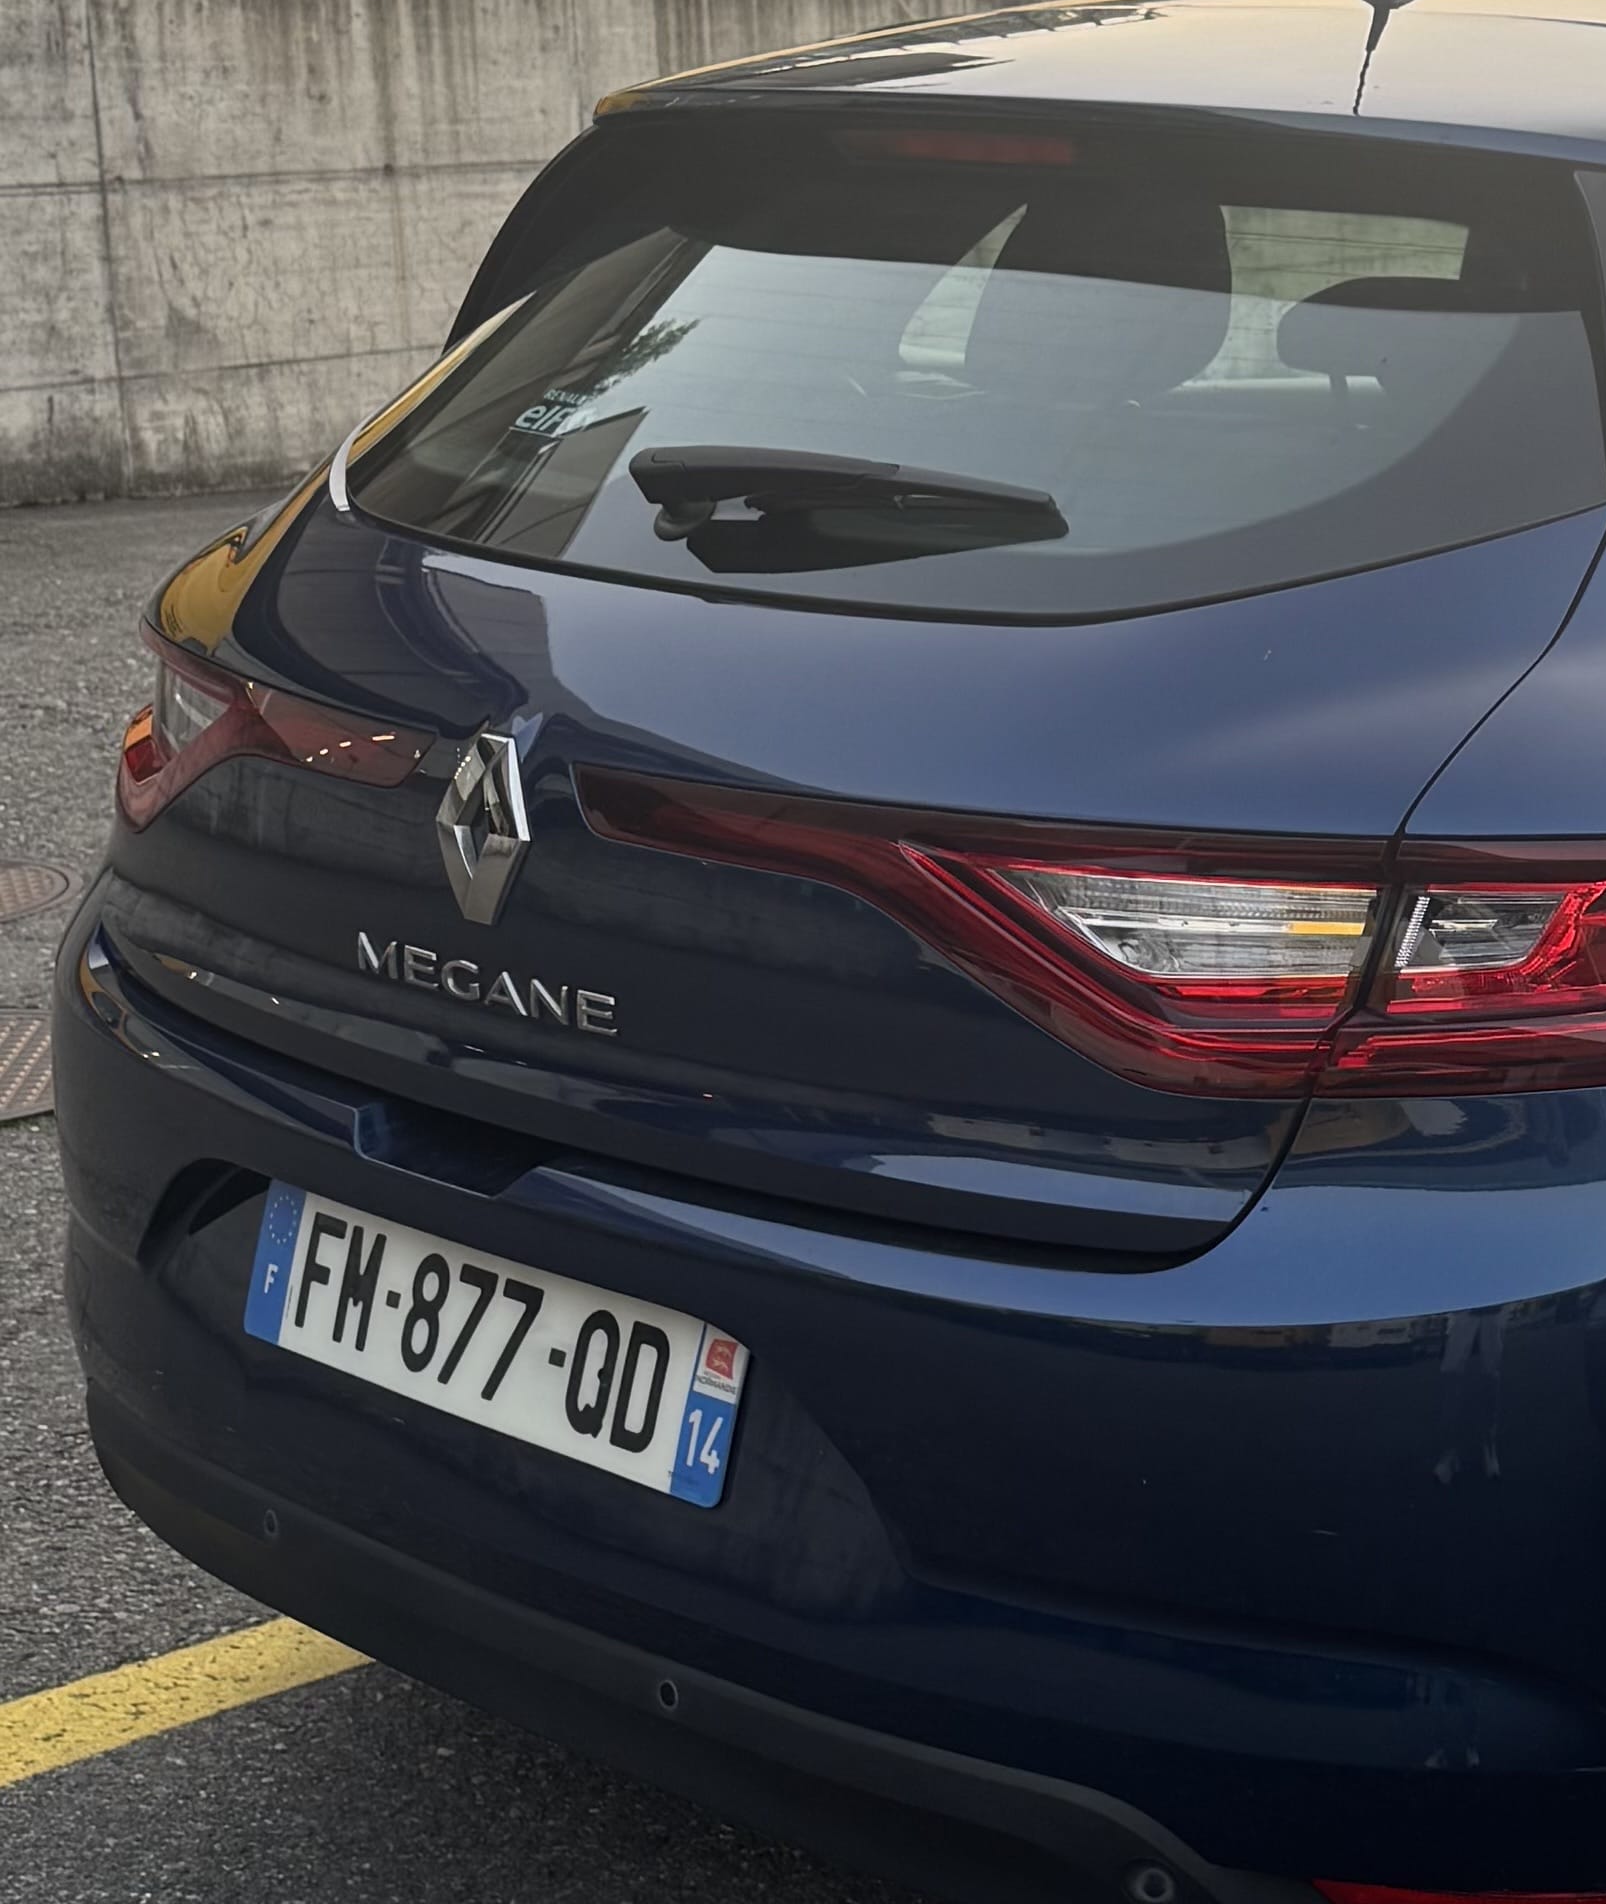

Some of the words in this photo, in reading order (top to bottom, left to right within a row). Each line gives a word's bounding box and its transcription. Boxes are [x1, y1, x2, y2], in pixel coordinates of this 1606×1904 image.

[356, 931, 618, 1038] MEGANE
[263, 1263, 279, 1294] F
[294, 1213, 671, 1454] FM-877-QD
[685, 1408, 723, 1475] 14
